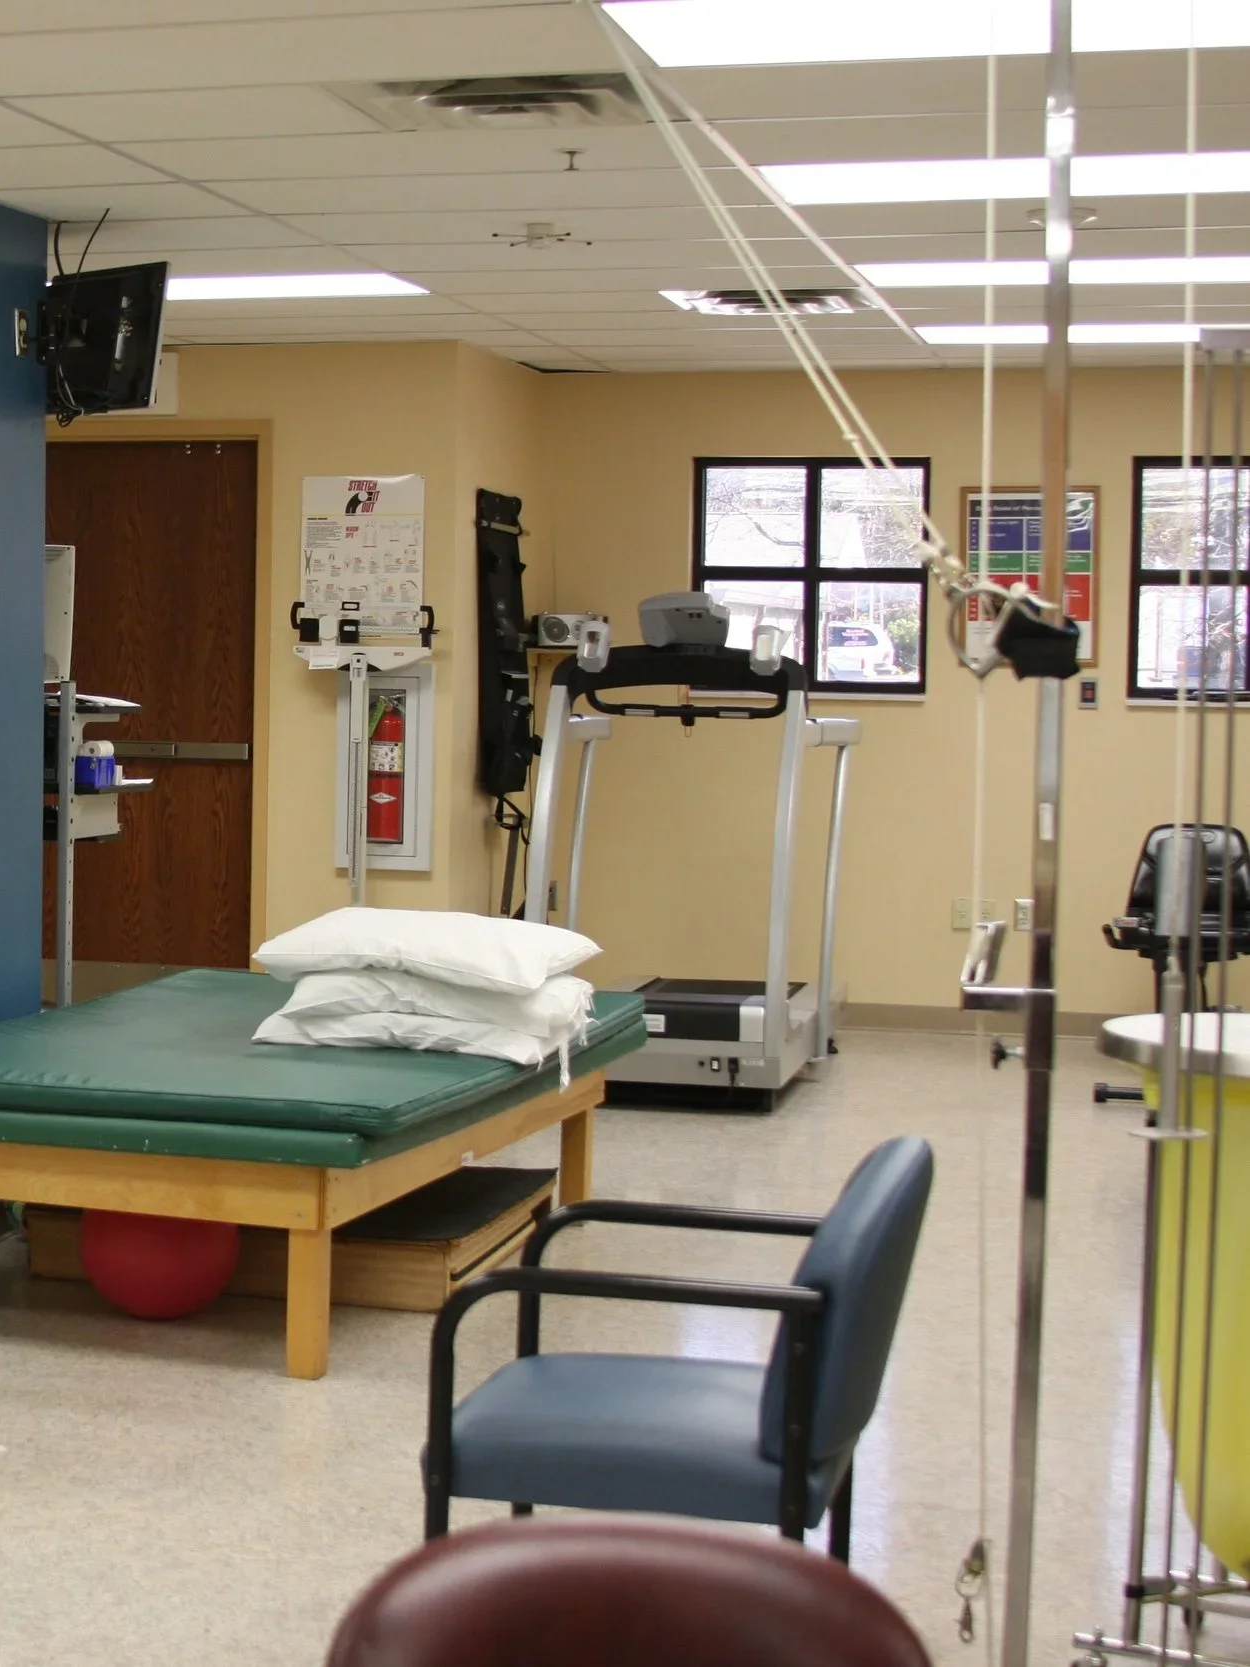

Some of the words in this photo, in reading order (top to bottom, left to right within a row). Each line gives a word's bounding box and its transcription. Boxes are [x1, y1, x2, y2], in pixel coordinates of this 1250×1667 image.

[348, 480, 377, 491] STRETCH
[373, 491, 380, 501] IT
[361, 502, 375, 513] OUT
